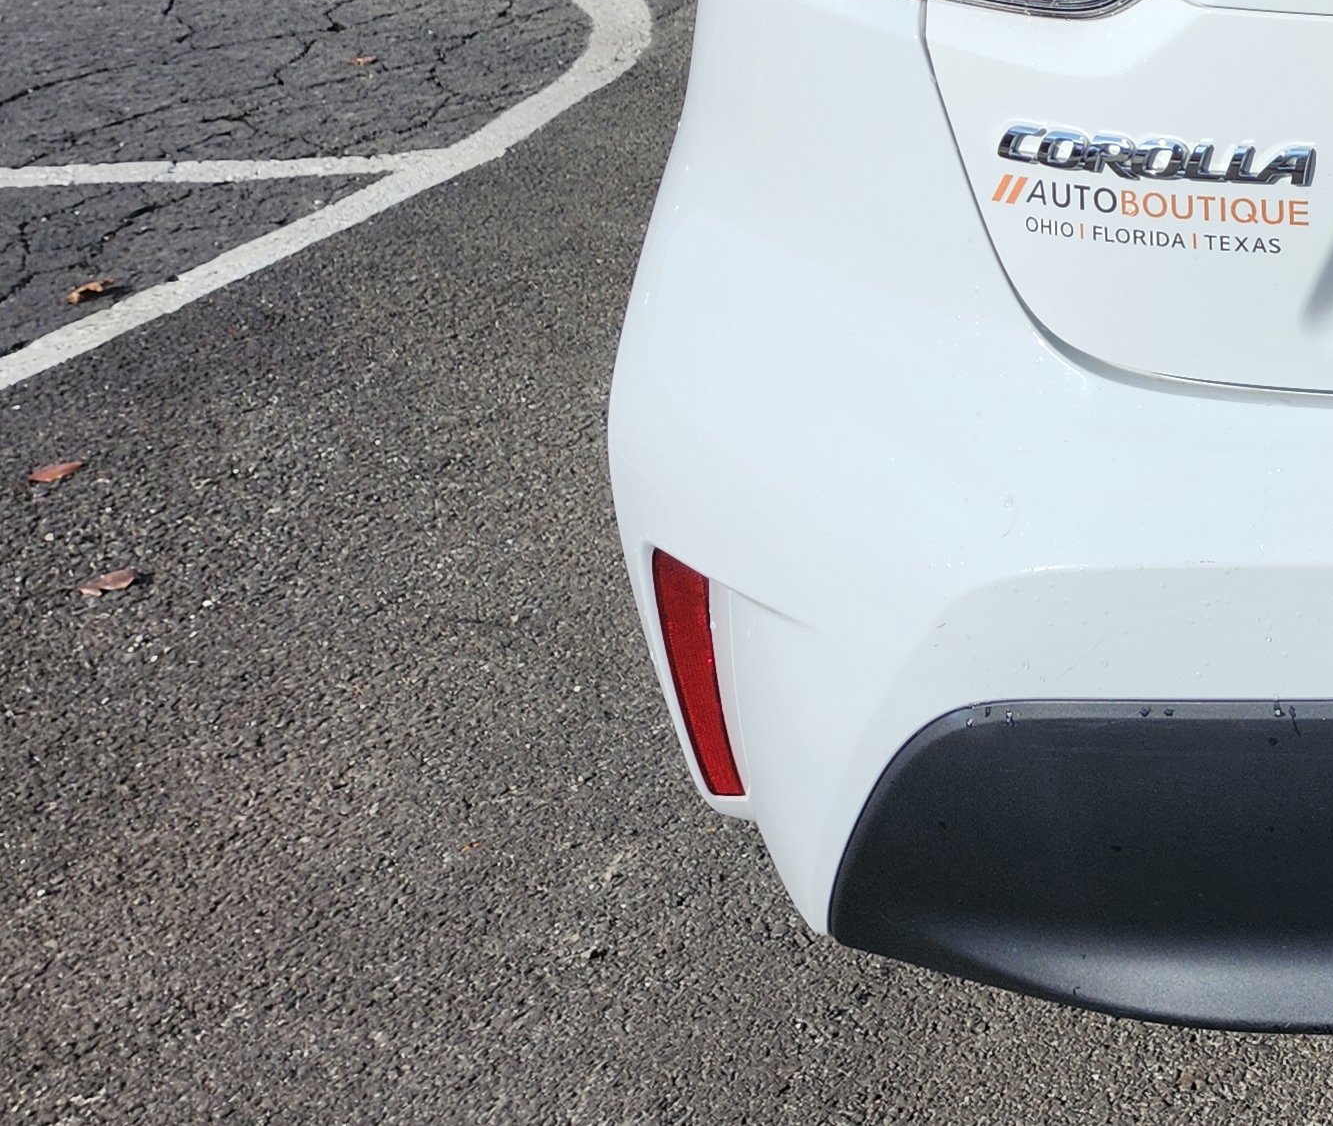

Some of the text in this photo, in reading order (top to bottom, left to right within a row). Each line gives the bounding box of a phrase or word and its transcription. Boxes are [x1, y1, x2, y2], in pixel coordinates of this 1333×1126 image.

[997, 124, 1317, 187] COROLLA
[1026, 179, 1310, 226] AUTOBOUTIQUE
[1025, 216, 1282, 254] OHIO FLORIDA TEXAS
